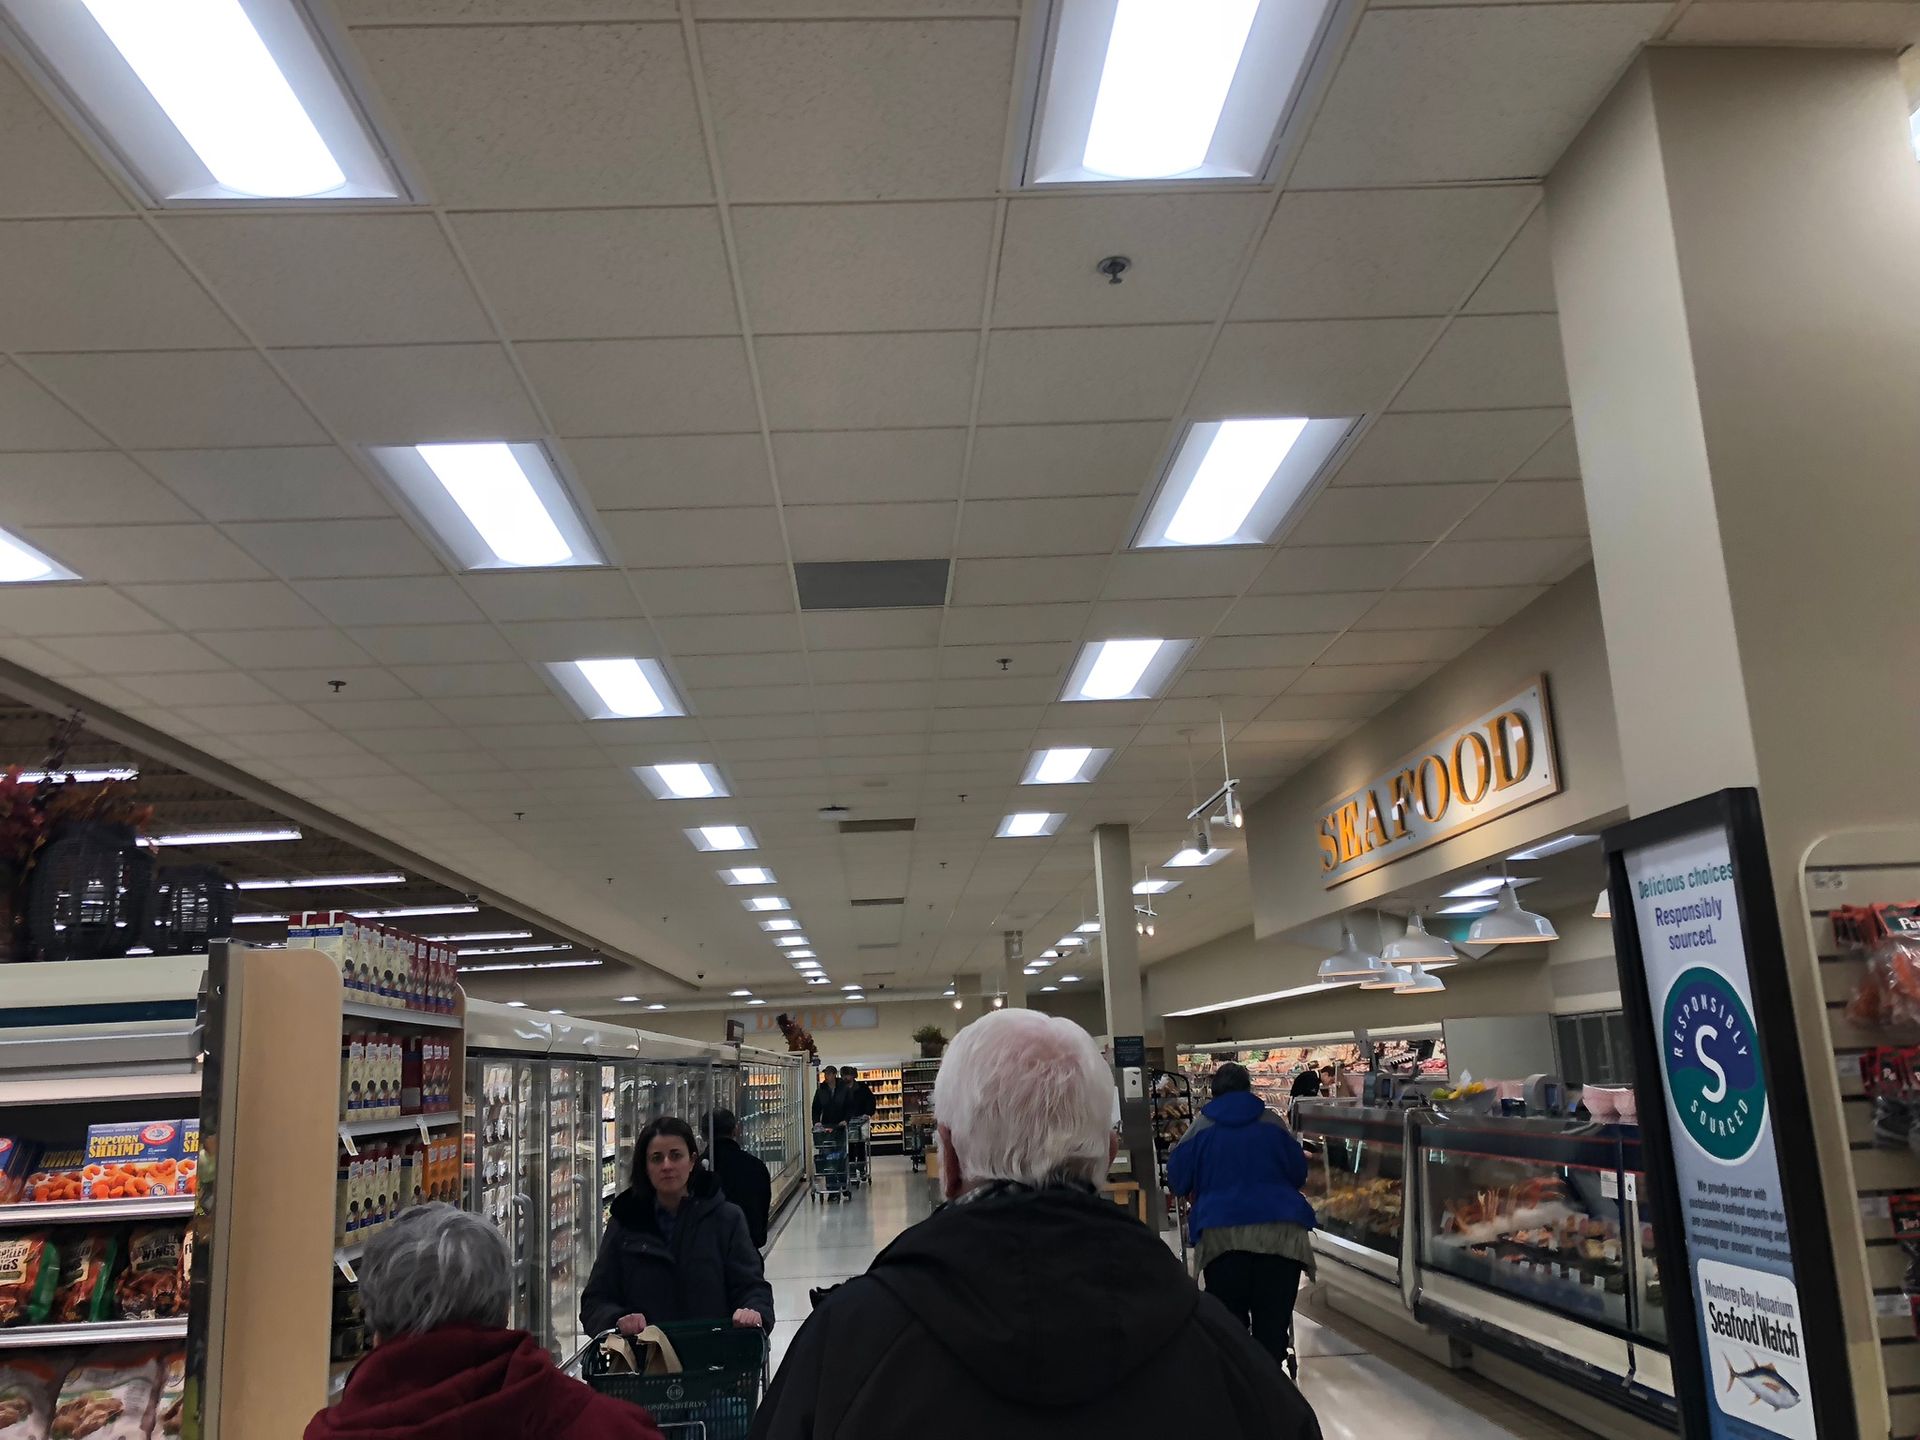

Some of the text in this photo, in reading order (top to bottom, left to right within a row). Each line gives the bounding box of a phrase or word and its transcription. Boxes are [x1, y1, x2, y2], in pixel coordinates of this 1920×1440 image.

[1317, 711, 1534, 872] SEAFOOD
[1638, 874, 1685, 899] Delicious
[1655, 896, 1722, 928] Responsibly
[1669, 924, 1716, 950] sourced.
[1674, 994, 1748, 1058] RESPONSIBLY
[1695, 1025, 1727, 1103] S
[1690, 1099, 1748, 1137] SOURCED
[88, 1142, 145, 1158] SHRIMP
[90, 1134, 139, 1146] POPCORN
[1704, 1279, 1794, 1319] Monterey Bay Aquarium
[1708, 1302, 1800, 1358] Seafood Watch
